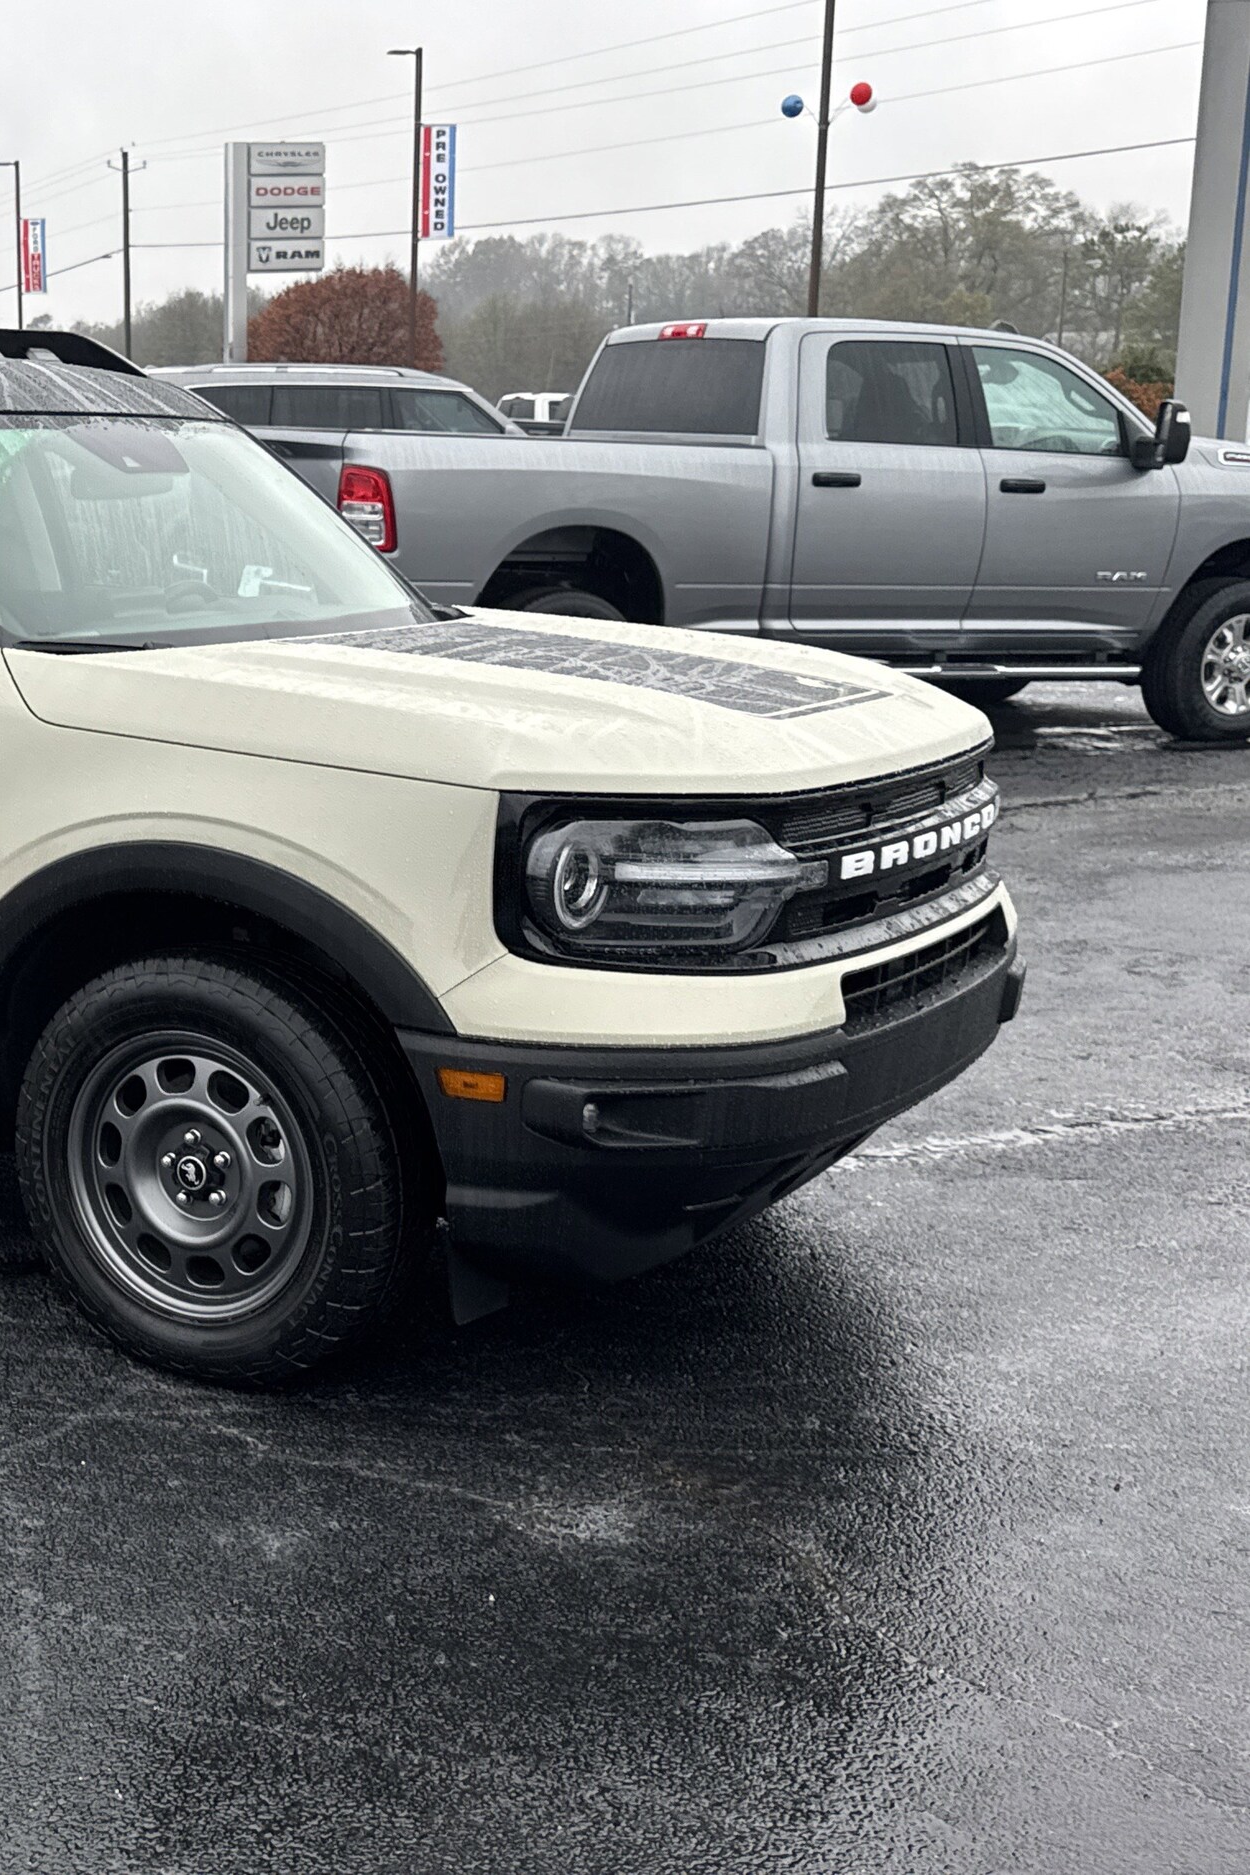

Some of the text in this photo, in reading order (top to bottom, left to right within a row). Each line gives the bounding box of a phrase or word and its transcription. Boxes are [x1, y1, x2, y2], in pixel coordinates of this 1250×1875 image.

[255, 186, 321, 197] DODGE
[433, 130, 447, 231] PRE OWNED
[265, 212, 312, 234] Jeep
[31, 226, 39, 252] FORD
[275, 249, 321, 260] RAM
[1095, 571, 1148, 581] RAM
[840, 803, 995, 880] BRONCO
